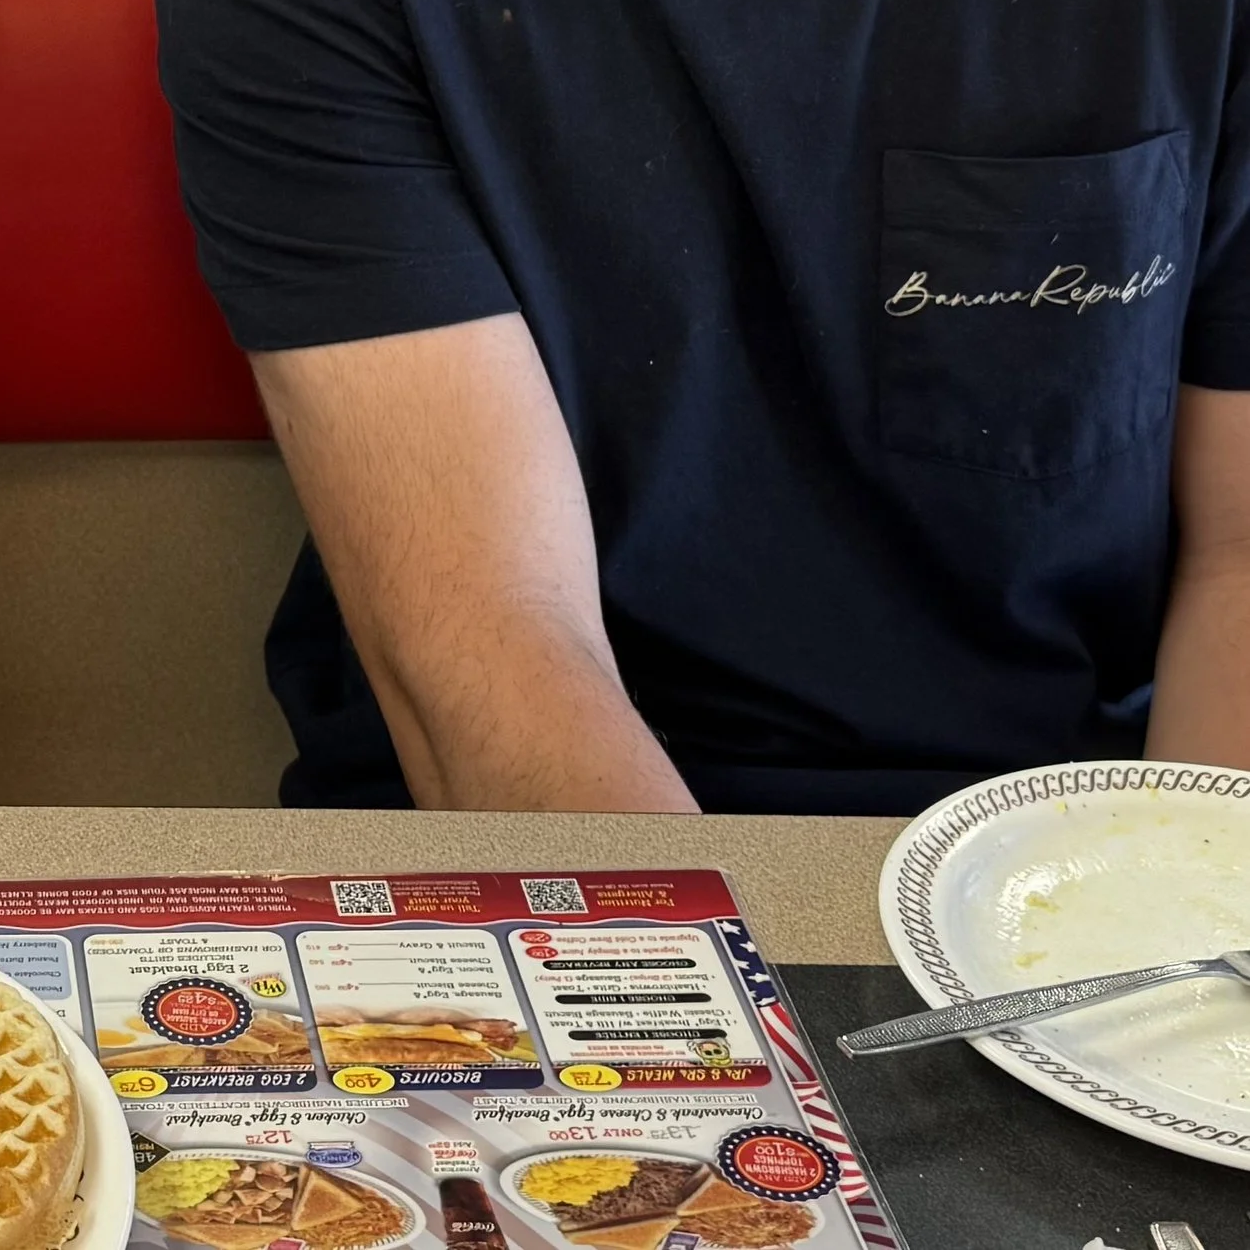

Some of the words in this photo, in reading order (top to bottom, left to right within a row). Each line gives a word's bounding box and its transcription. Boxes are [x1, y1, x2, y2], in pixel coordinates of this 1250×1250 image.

[884, 270, 1030, 318] Banana
[1028, 254, 1177, 316] Republic
[36, 890, 68, 898] BORNE
[72, 890, 98, 898] FOOD
[101, 889, 112, 897] OF
[116, 888, 138, 897] RISK
[141, 888, 166, 896] YOUR
[168, 887, 216, 896] INCREASE
[596, 889, 654, 898] Allergens
[72, 897, 144, 906] UNDERCOOKED
[166, 896, 188, 904] RAW
[192, 895, 250, 904] CONSUMING
[596, 898, 652, 907] Nutrition
[77, 907, 114, 915] STEAKS
[117, 906, 136, 914] AND
[139, 906, 164, 914] EGGS
[218, 904, 255, 913] HEALTH
[404, 904, 436, 912] about
[12, 940, 57, 949] Blueberry
[177, 945, 258, 953] HASHBROWNS
[398, 940, 432, 950] Gravy
[446, 942, 485, 950] Biscuit
[26, 956, 59, 964] Peanut
[128, 964, 198, 976] Breakfast
[239, 964, 250, 973] 2
[14, 970, 61, 978] Chocolate
[575, 974, 622, 982] Sausage
[674, 974, 708, 982] Bacon
[552, 984, 584, 992] Toast
[630, 983, 700, 991] Hashbrowns
[642, 1010, 682, 1018] Waffle
[180, 1024, 208, 1032] ADD
[550, 1020, 581, 1028] Toast
[296, 1074, 306, 1084] 2
[400, 1071, 482, 1084] BISCUITS
[626, 1069, 675, 1082] MEALS
[710, 1068, 721, 1081] &
[170, 1074, 255, 1088] BREAKFAST
[261, 1074, 292, 1086] EGG
[122, 1102, 164, 1111] TOAST
[178, 1101, 250, 1110] SCATTERED
[254, 1100, 342, 1109] HASHBROWNS
[344, 1098, 407, 1108] INCLUDES
[473, 1102, 550, 1122] Breakfast
[600, 1108, 652, 1121] Cheese
[656, 1108, 667, 1120] &
[670, 1107, 763, 1120] Cheesesteak
[165, 1112, 242, 1128] Breakfast
[290, 1112, 302, 1125] &
[304, 1112, 366, 1125] Chicken
[602, 1128, 643, 1138] ONLY
[753, 1154, 803, 1167] TOPPINGS
[745, 1163, 807, 1176] HASHBROWN
[809, 1168, 816, 1176] 2
